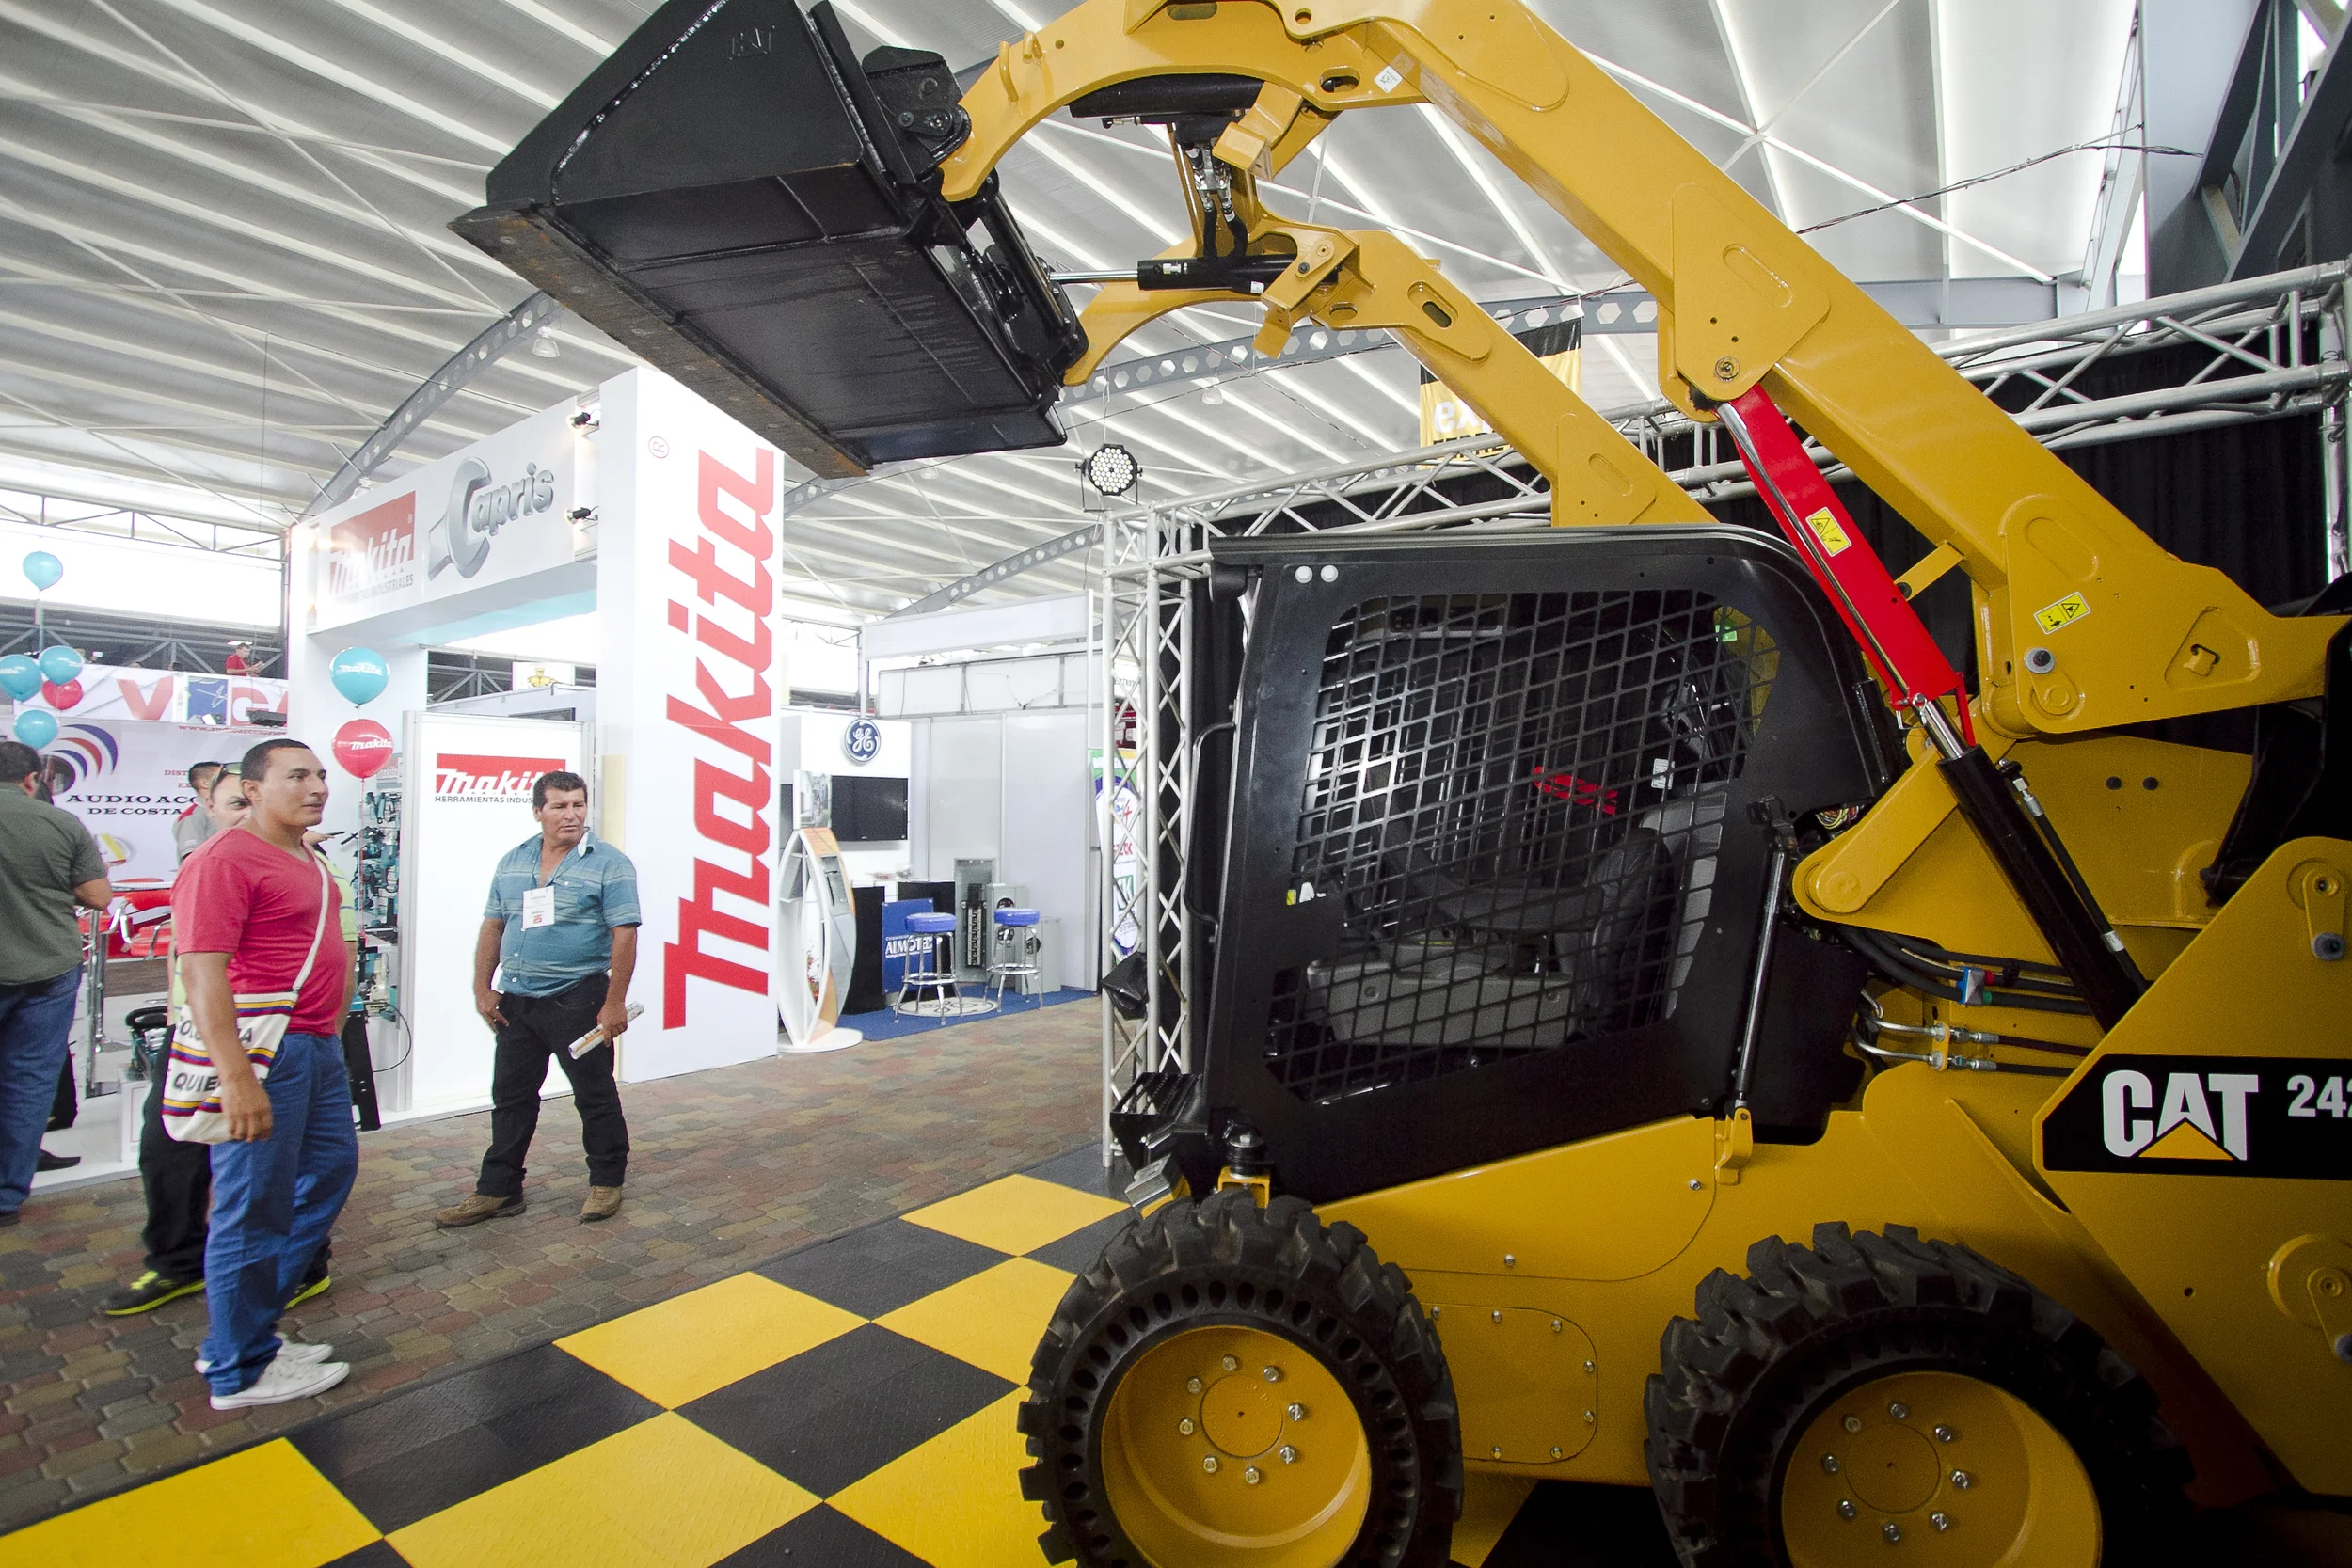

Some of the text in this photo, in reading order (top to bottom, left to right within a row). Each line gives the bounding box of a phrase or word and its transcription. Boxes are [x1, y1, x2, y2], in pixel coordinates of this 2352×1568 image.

[444, 456, 555, 579] Capris
[66, 795, 151, 803] AUDIO
[435, 795, 505, 804] HERRAMIENTAS
[120, 807, 182, 816] COSTA
[2102, 1069, 2352, 1161] CAT 24
